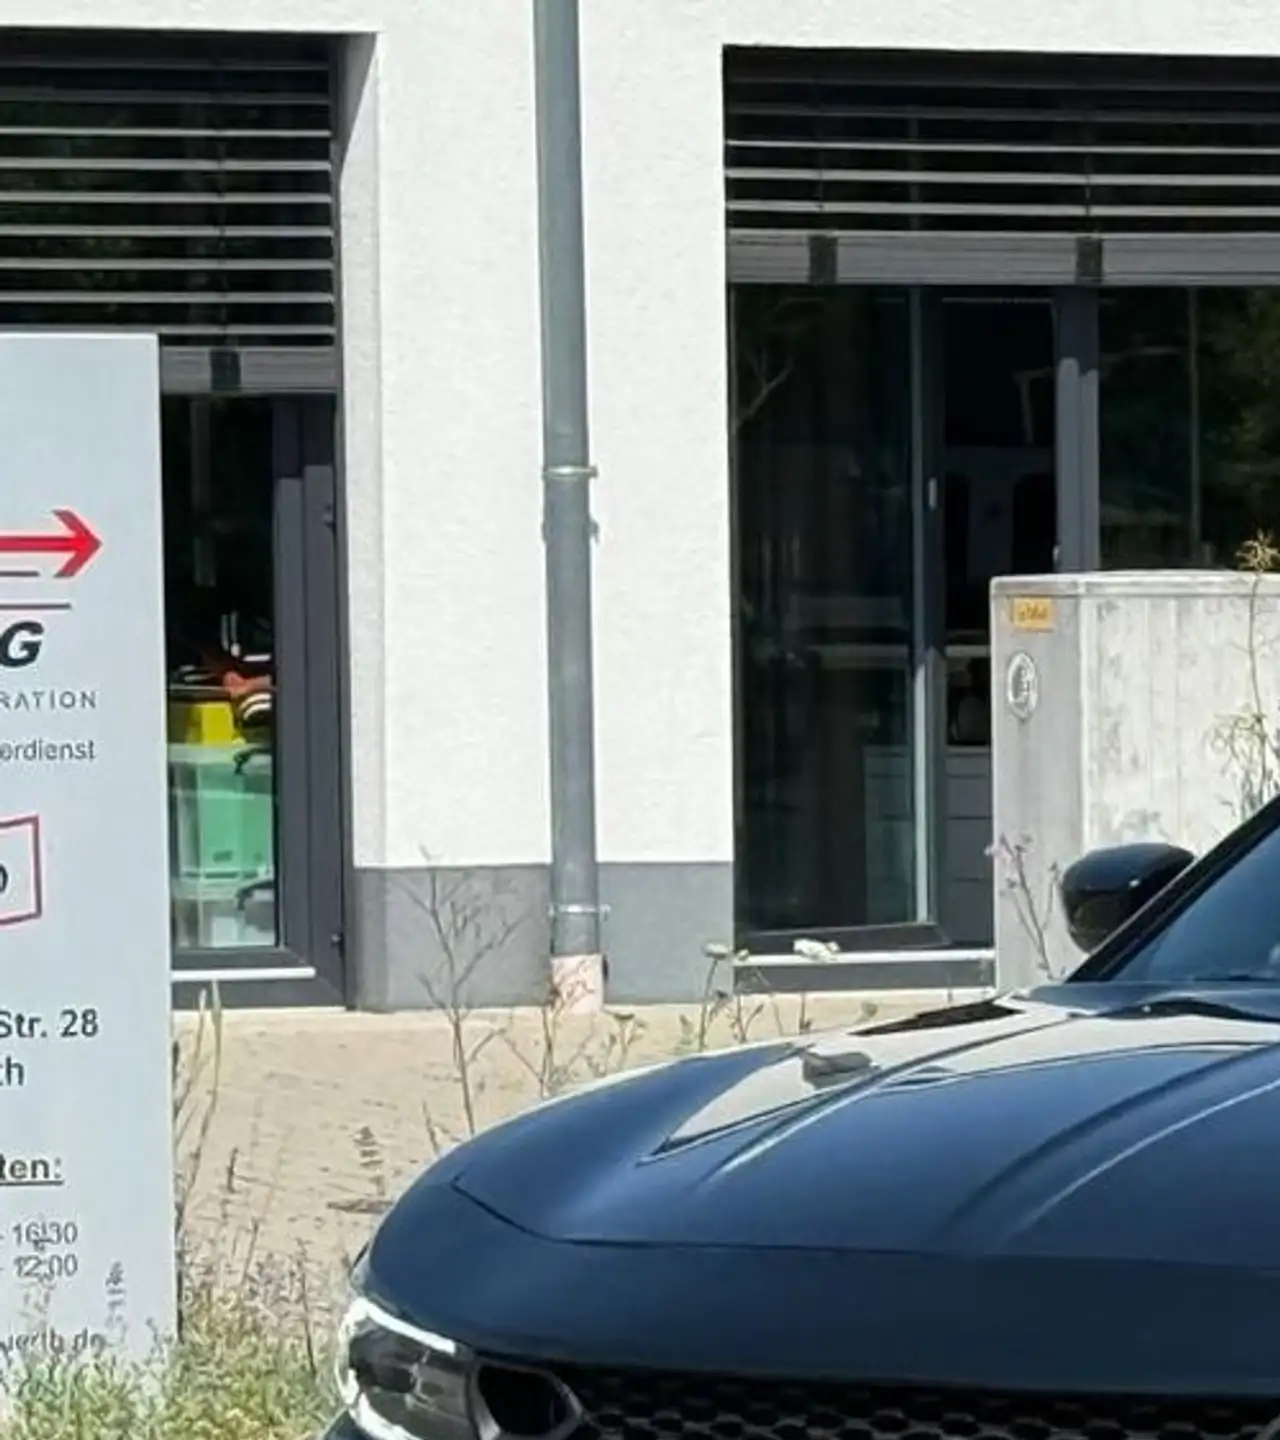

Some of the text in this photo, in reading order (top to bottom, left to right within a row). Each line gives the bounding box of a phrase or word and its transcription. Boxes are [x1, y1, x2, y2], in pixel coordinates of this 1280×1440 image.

[0, 1008, 99, 1038] Str. 28
[0, 1056, 24, 1086] h
